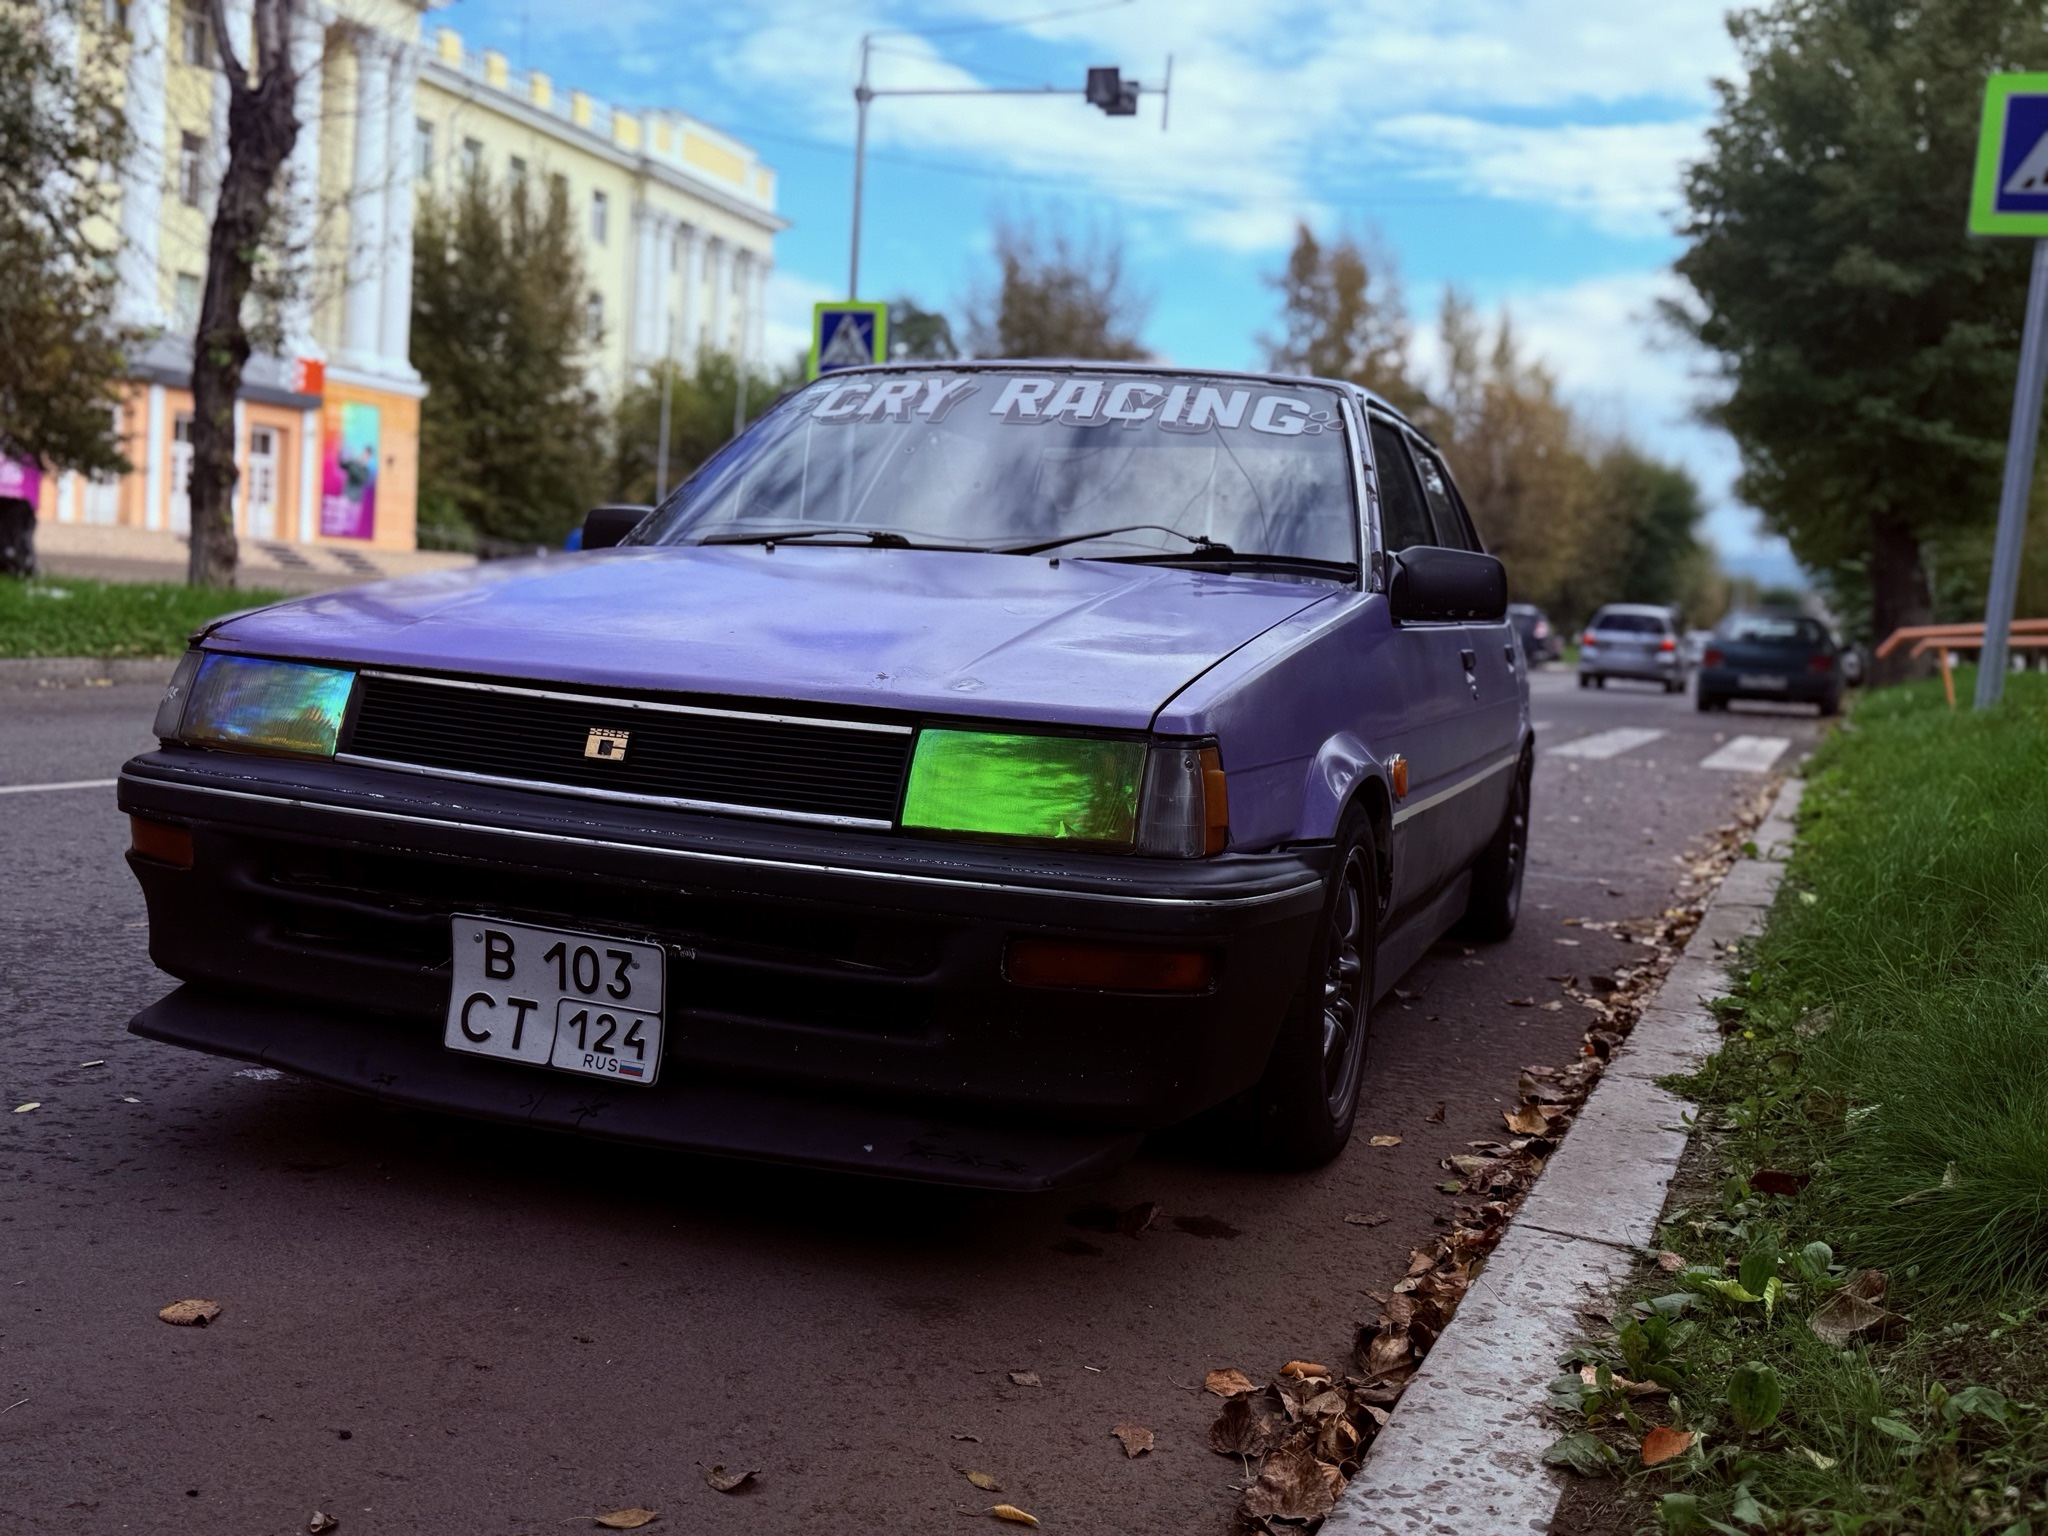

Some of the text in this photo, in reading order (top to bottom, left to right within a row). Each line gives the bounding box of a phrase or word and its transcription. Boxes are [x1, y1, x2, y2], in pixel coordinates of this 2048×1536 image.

[811, 377, 973, 419] CRY
[990, 378, 1310, 436] RACING
[543, 941, 634, 1000] 103
[568, 1009, 646, 1061] 124
[582, 1053, 619, 1073] RUS
